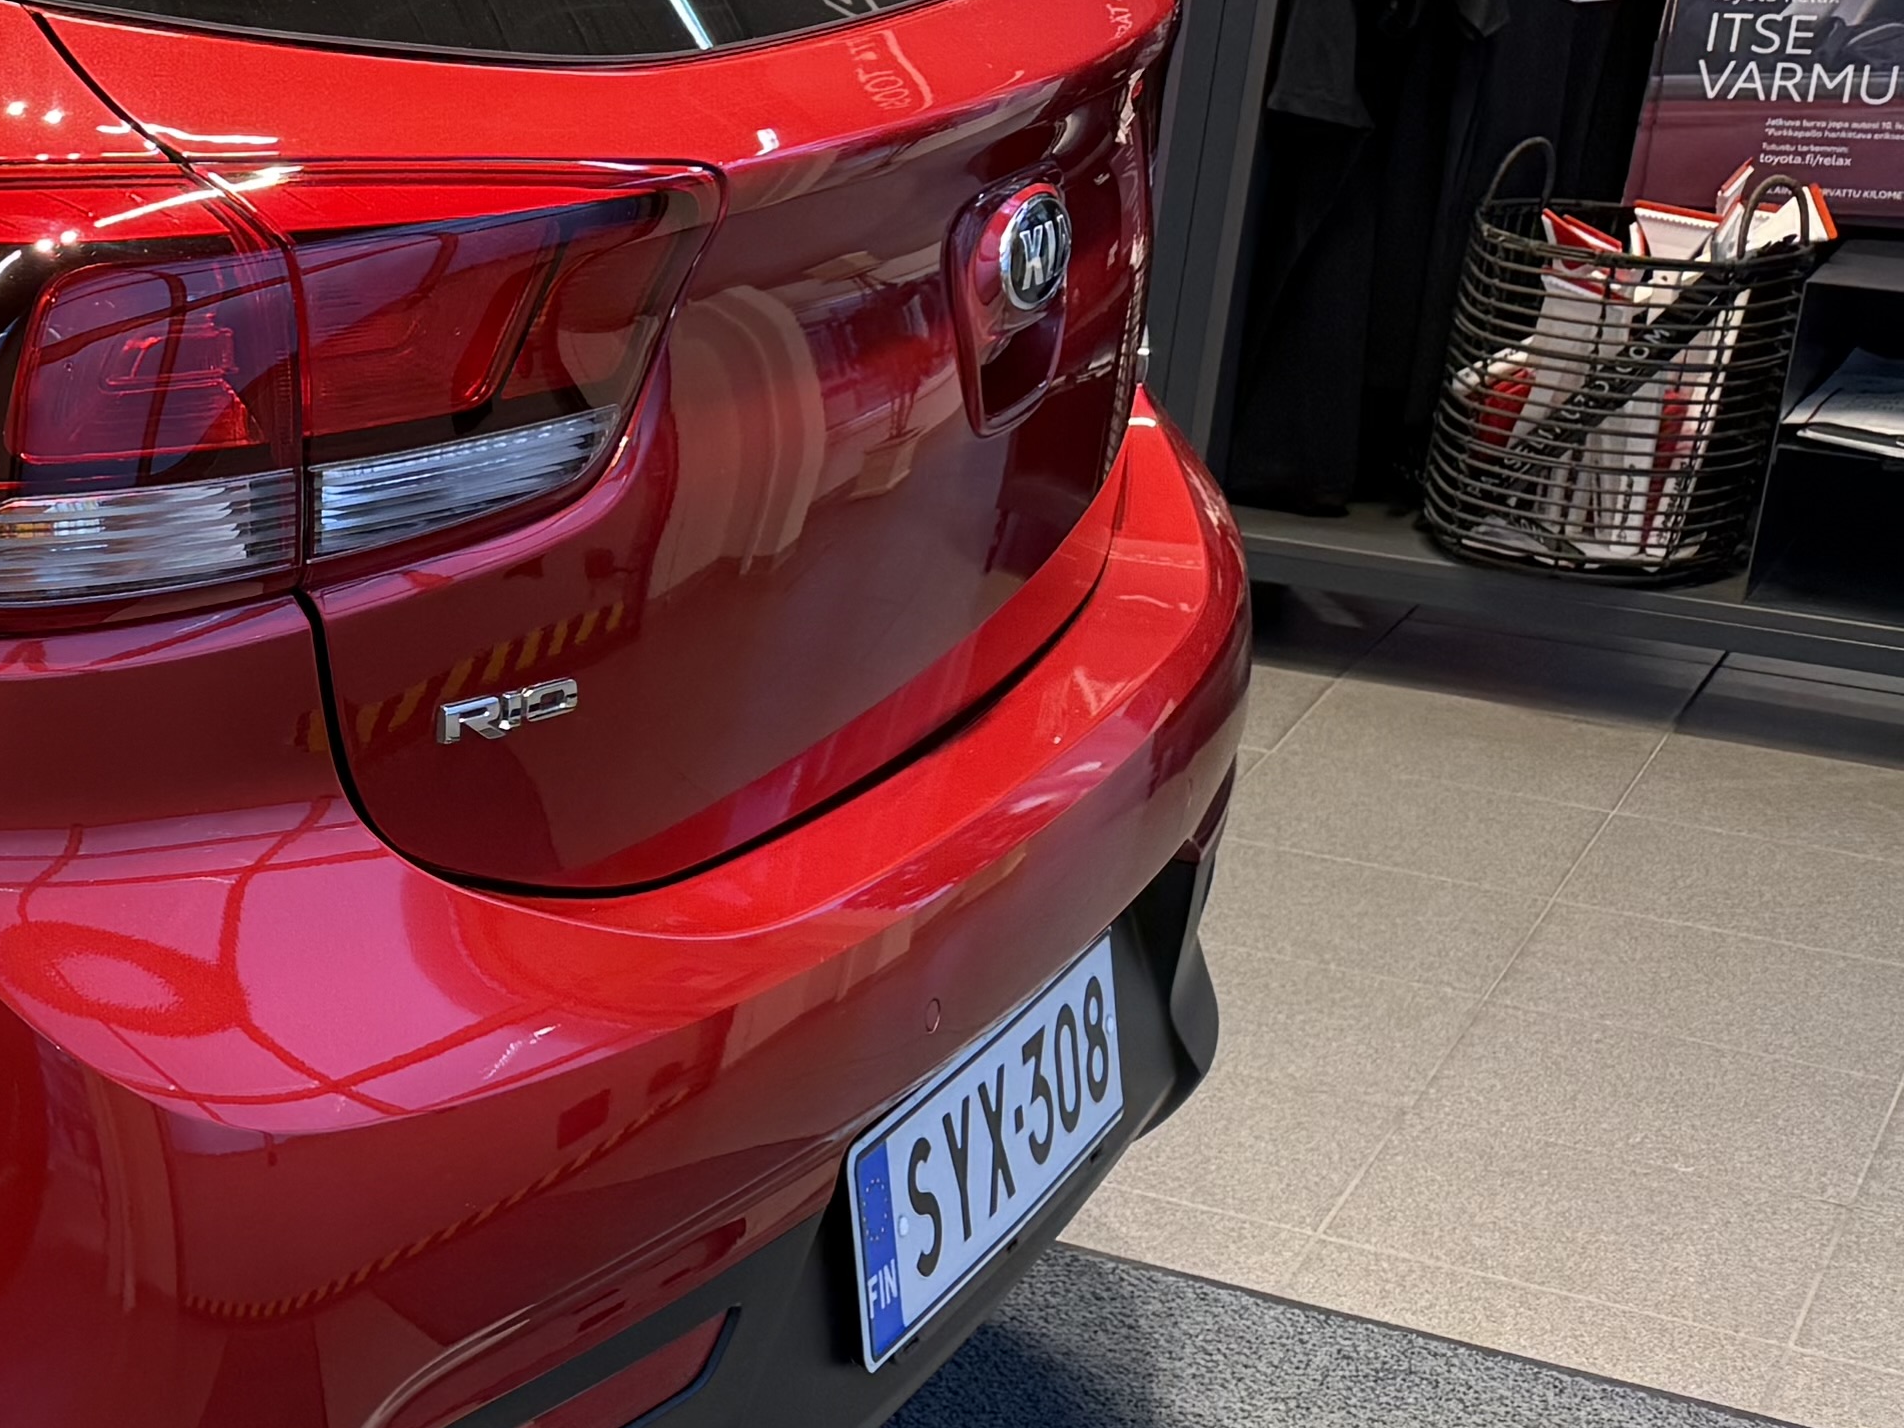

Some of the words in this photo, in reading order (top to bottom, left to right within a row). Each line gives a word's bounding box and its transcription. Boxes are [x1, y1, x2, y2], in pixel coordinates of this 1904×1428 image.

[1706, 12, 1818, 55] ITSE
[1698, 59, 1899, 106] VARMU
[1759, 153, 1852, 166] toyota.fi/relax
[437, 677, 578, 744] RIO
[907, 976, 1109, 1278] SYX-308
[867, 1259, 899, 1319] FIN
